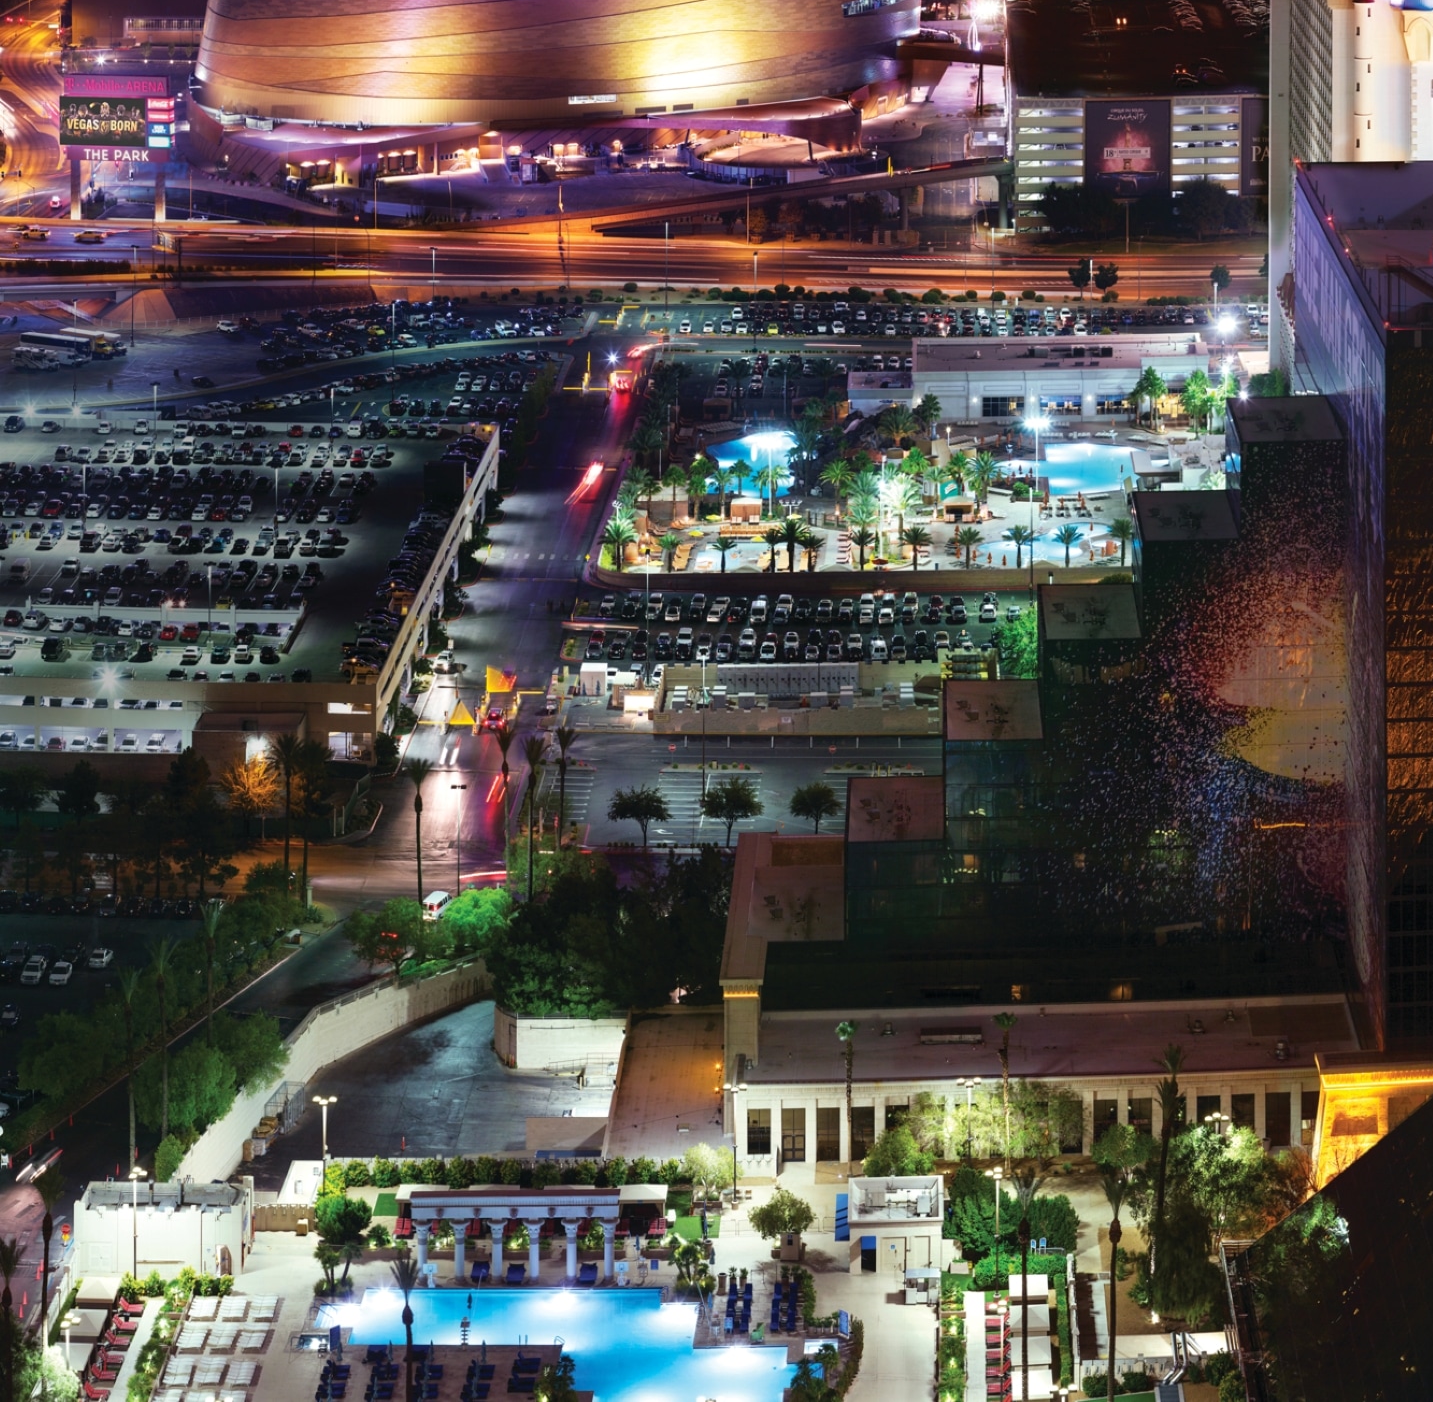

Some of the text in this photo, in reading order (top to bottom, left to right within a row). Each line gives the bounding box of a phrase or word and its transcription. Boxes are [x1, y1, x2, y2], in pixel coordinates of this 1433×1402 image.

[126, 80, 166, 93] ARENA
[66, 118, 138, 132] VEGAS BORN
[84, 148, 150, 162] THE PARK
